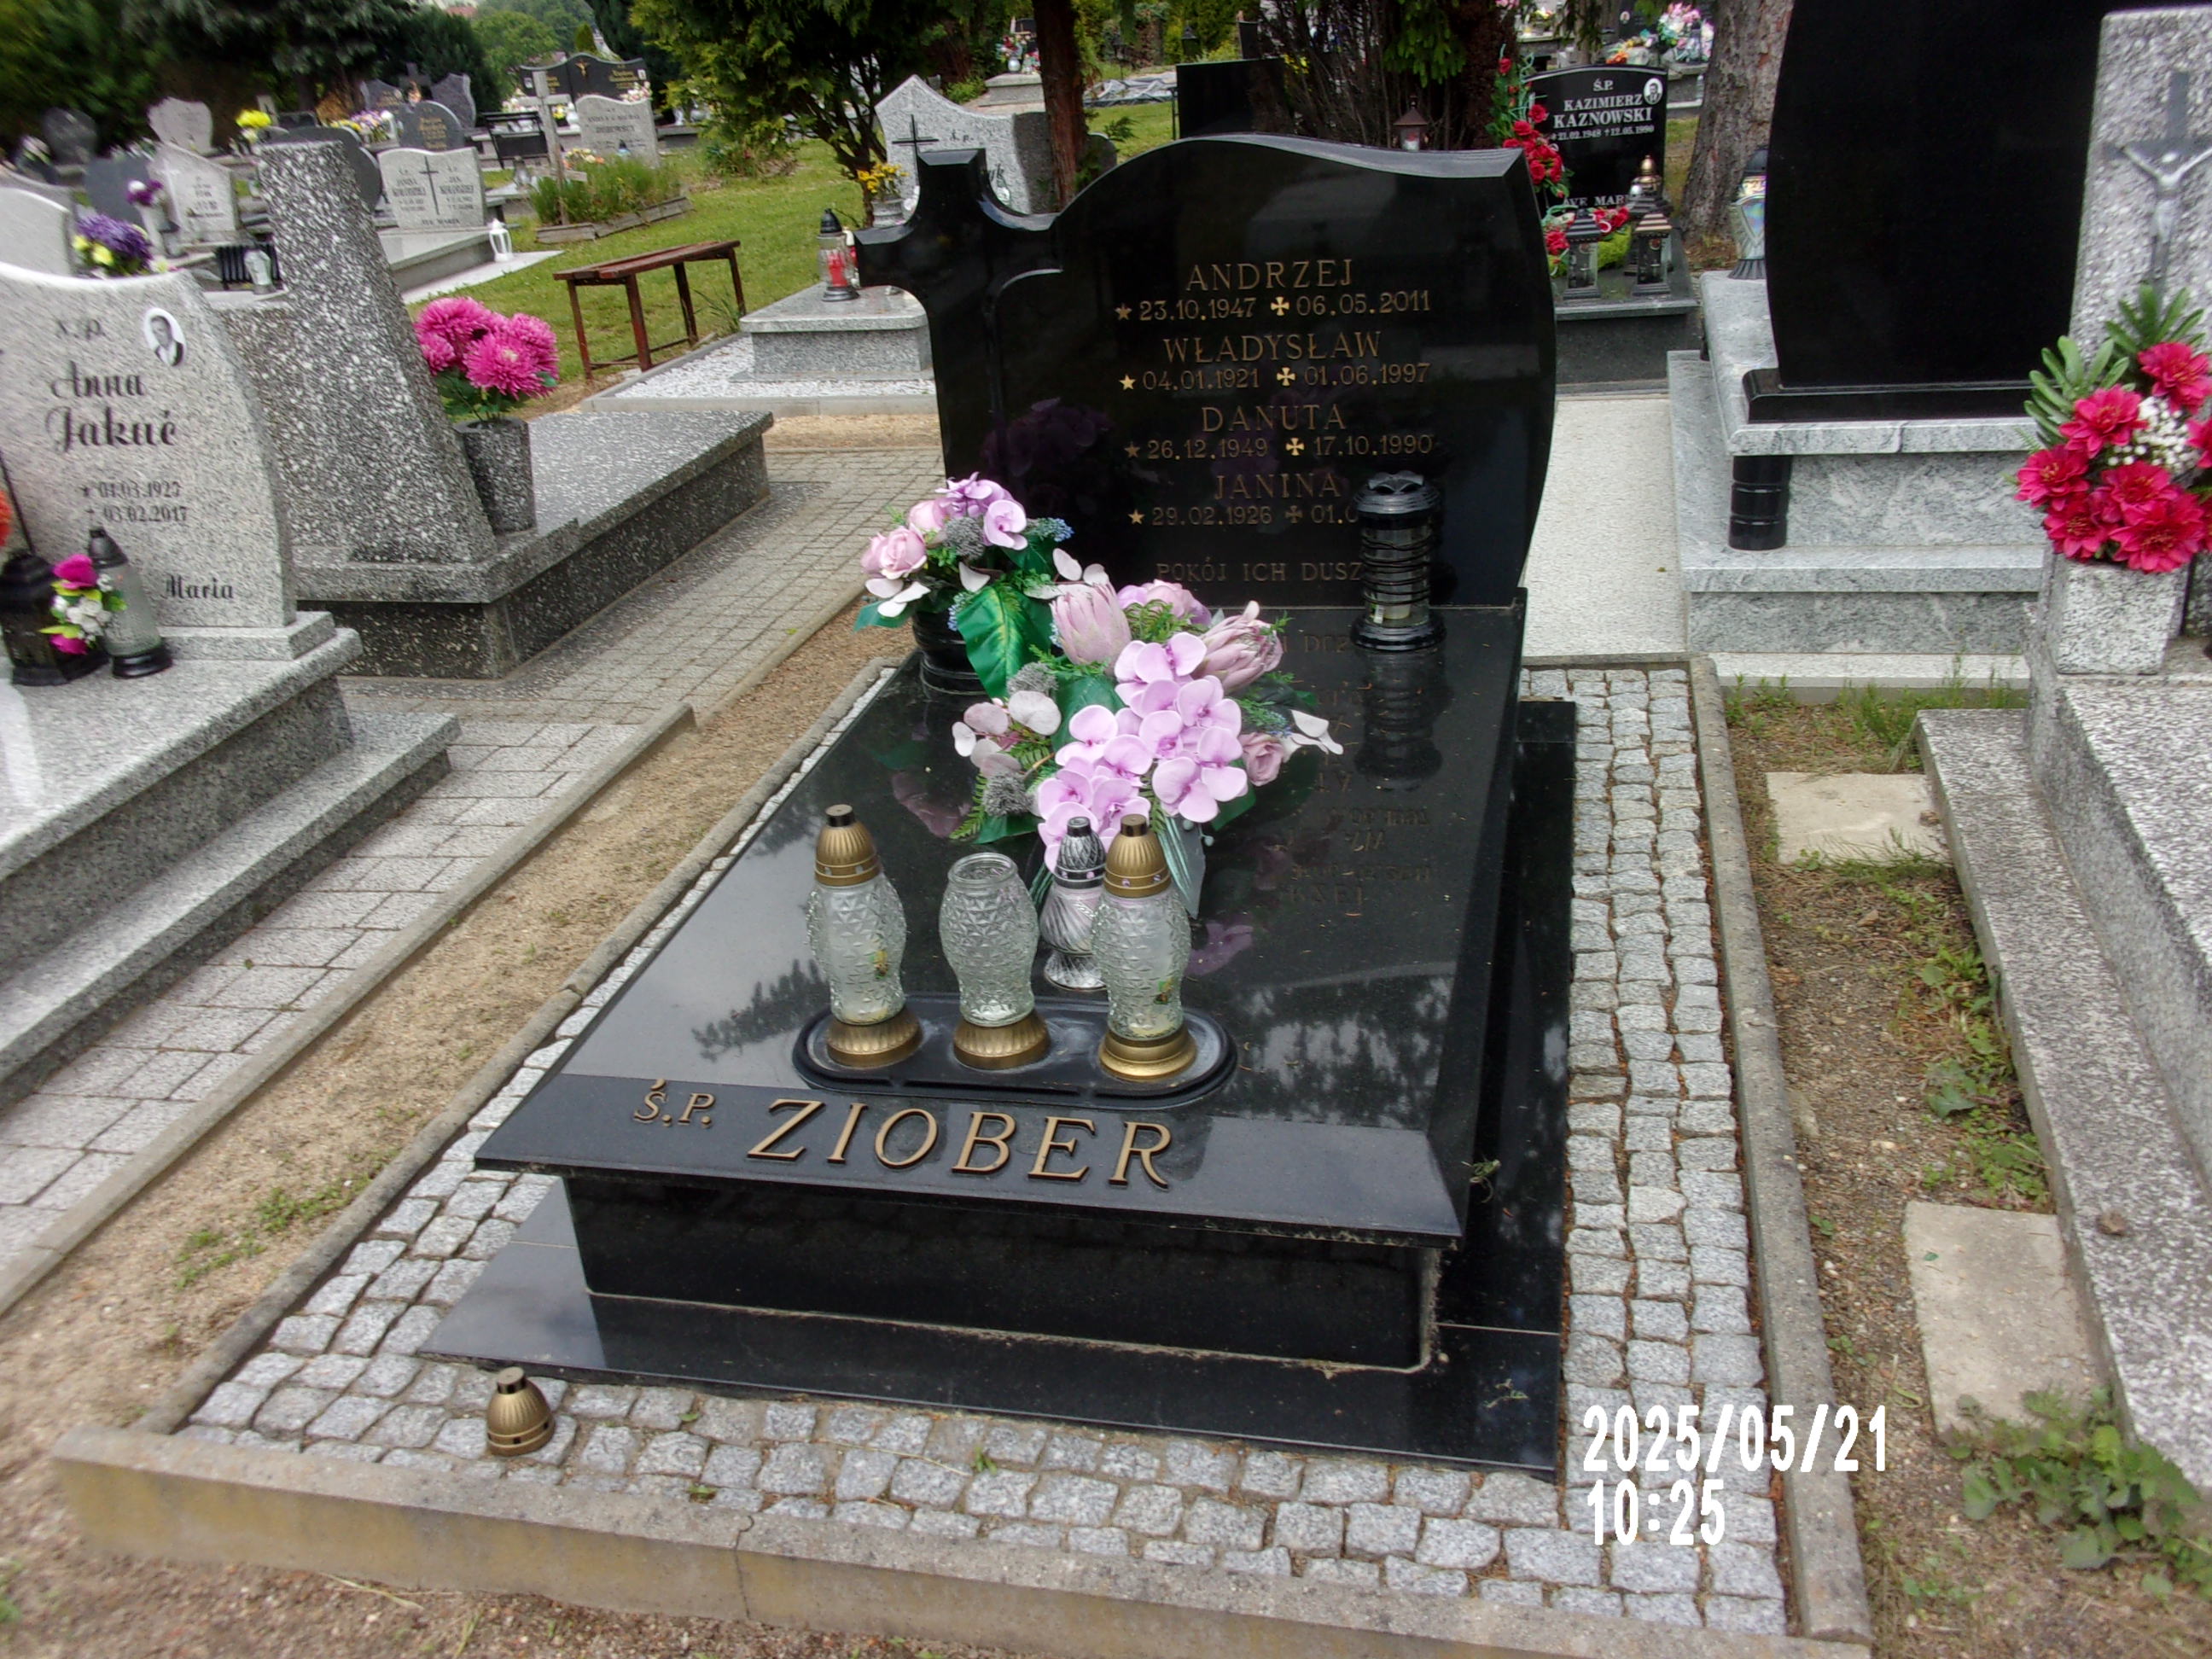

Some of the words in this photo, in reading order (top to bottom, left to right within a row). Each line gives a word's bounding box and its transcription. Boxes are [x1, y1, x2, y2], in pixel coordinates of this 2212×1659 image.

[1563, 94, 1643, 112] KAZIMIERZ
[1553, 107, 1653, 129] KAZNOWSKI
[1594, 195, 1628, 207] MAR
[1185, 259, 1353, 292] ANDRZEJ
[1139, 297, 1257, 321] 23.10.1947
[1296, 289, 1431, 316] 06.05.2011
[1163, 330, 1382, 364] WŁADYSŁAW
[50, 360, 147, 399] Anna
[1142, 368, 1260, 392] 04.01.1921
[1303, 362, 1431, 387] 01.06.1997
[1202, 404, 1346, 433] DANUTA
[1147, 437, 1269, 461] 26.12.1949
[1315, 434, 1435, 457] 17.10.1990
[1214, 473, 1342, 500] JANINA
[1151, 505, 1272, 527] 29.02.1926
[1156, 556, 1226, 582] POKÓJ
[1243, 562, 1286, 582] ICH
[1301, 562, 1363, 582] DUSZ
[166, 575, 233, 600] Maria
[633, 1079, 715, 1130] Ś.P.
[747, 1098, 1172, 1190] ZIOBER
